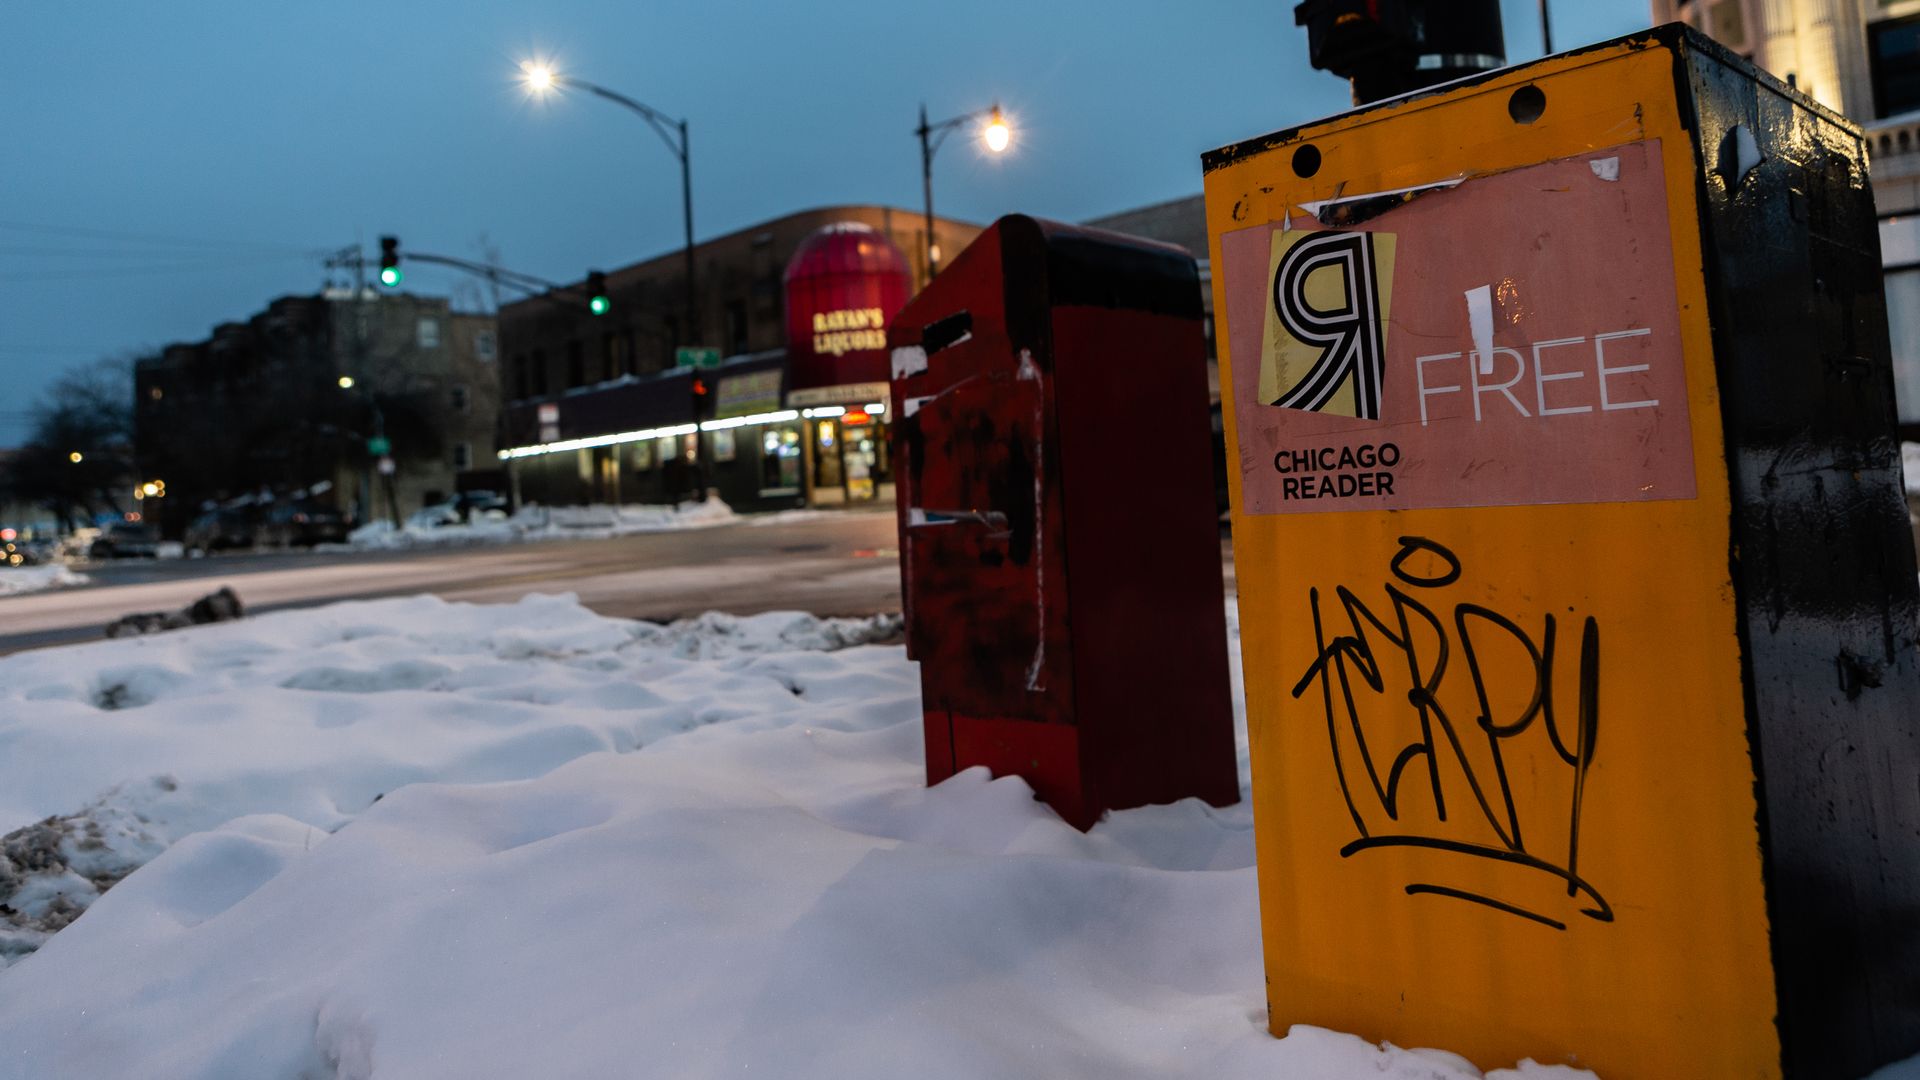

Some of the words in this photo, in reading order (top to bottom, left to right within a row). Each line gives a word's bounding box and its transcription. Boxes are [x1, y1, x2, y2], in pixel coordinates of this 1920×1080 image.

[813, 330, 886, 356] LIQUORS
[1416, 328, 1659, 426] FREE
[1274, 443, 1400, 473] CHICAGO
[1282, 472, 1394, 500] READER
